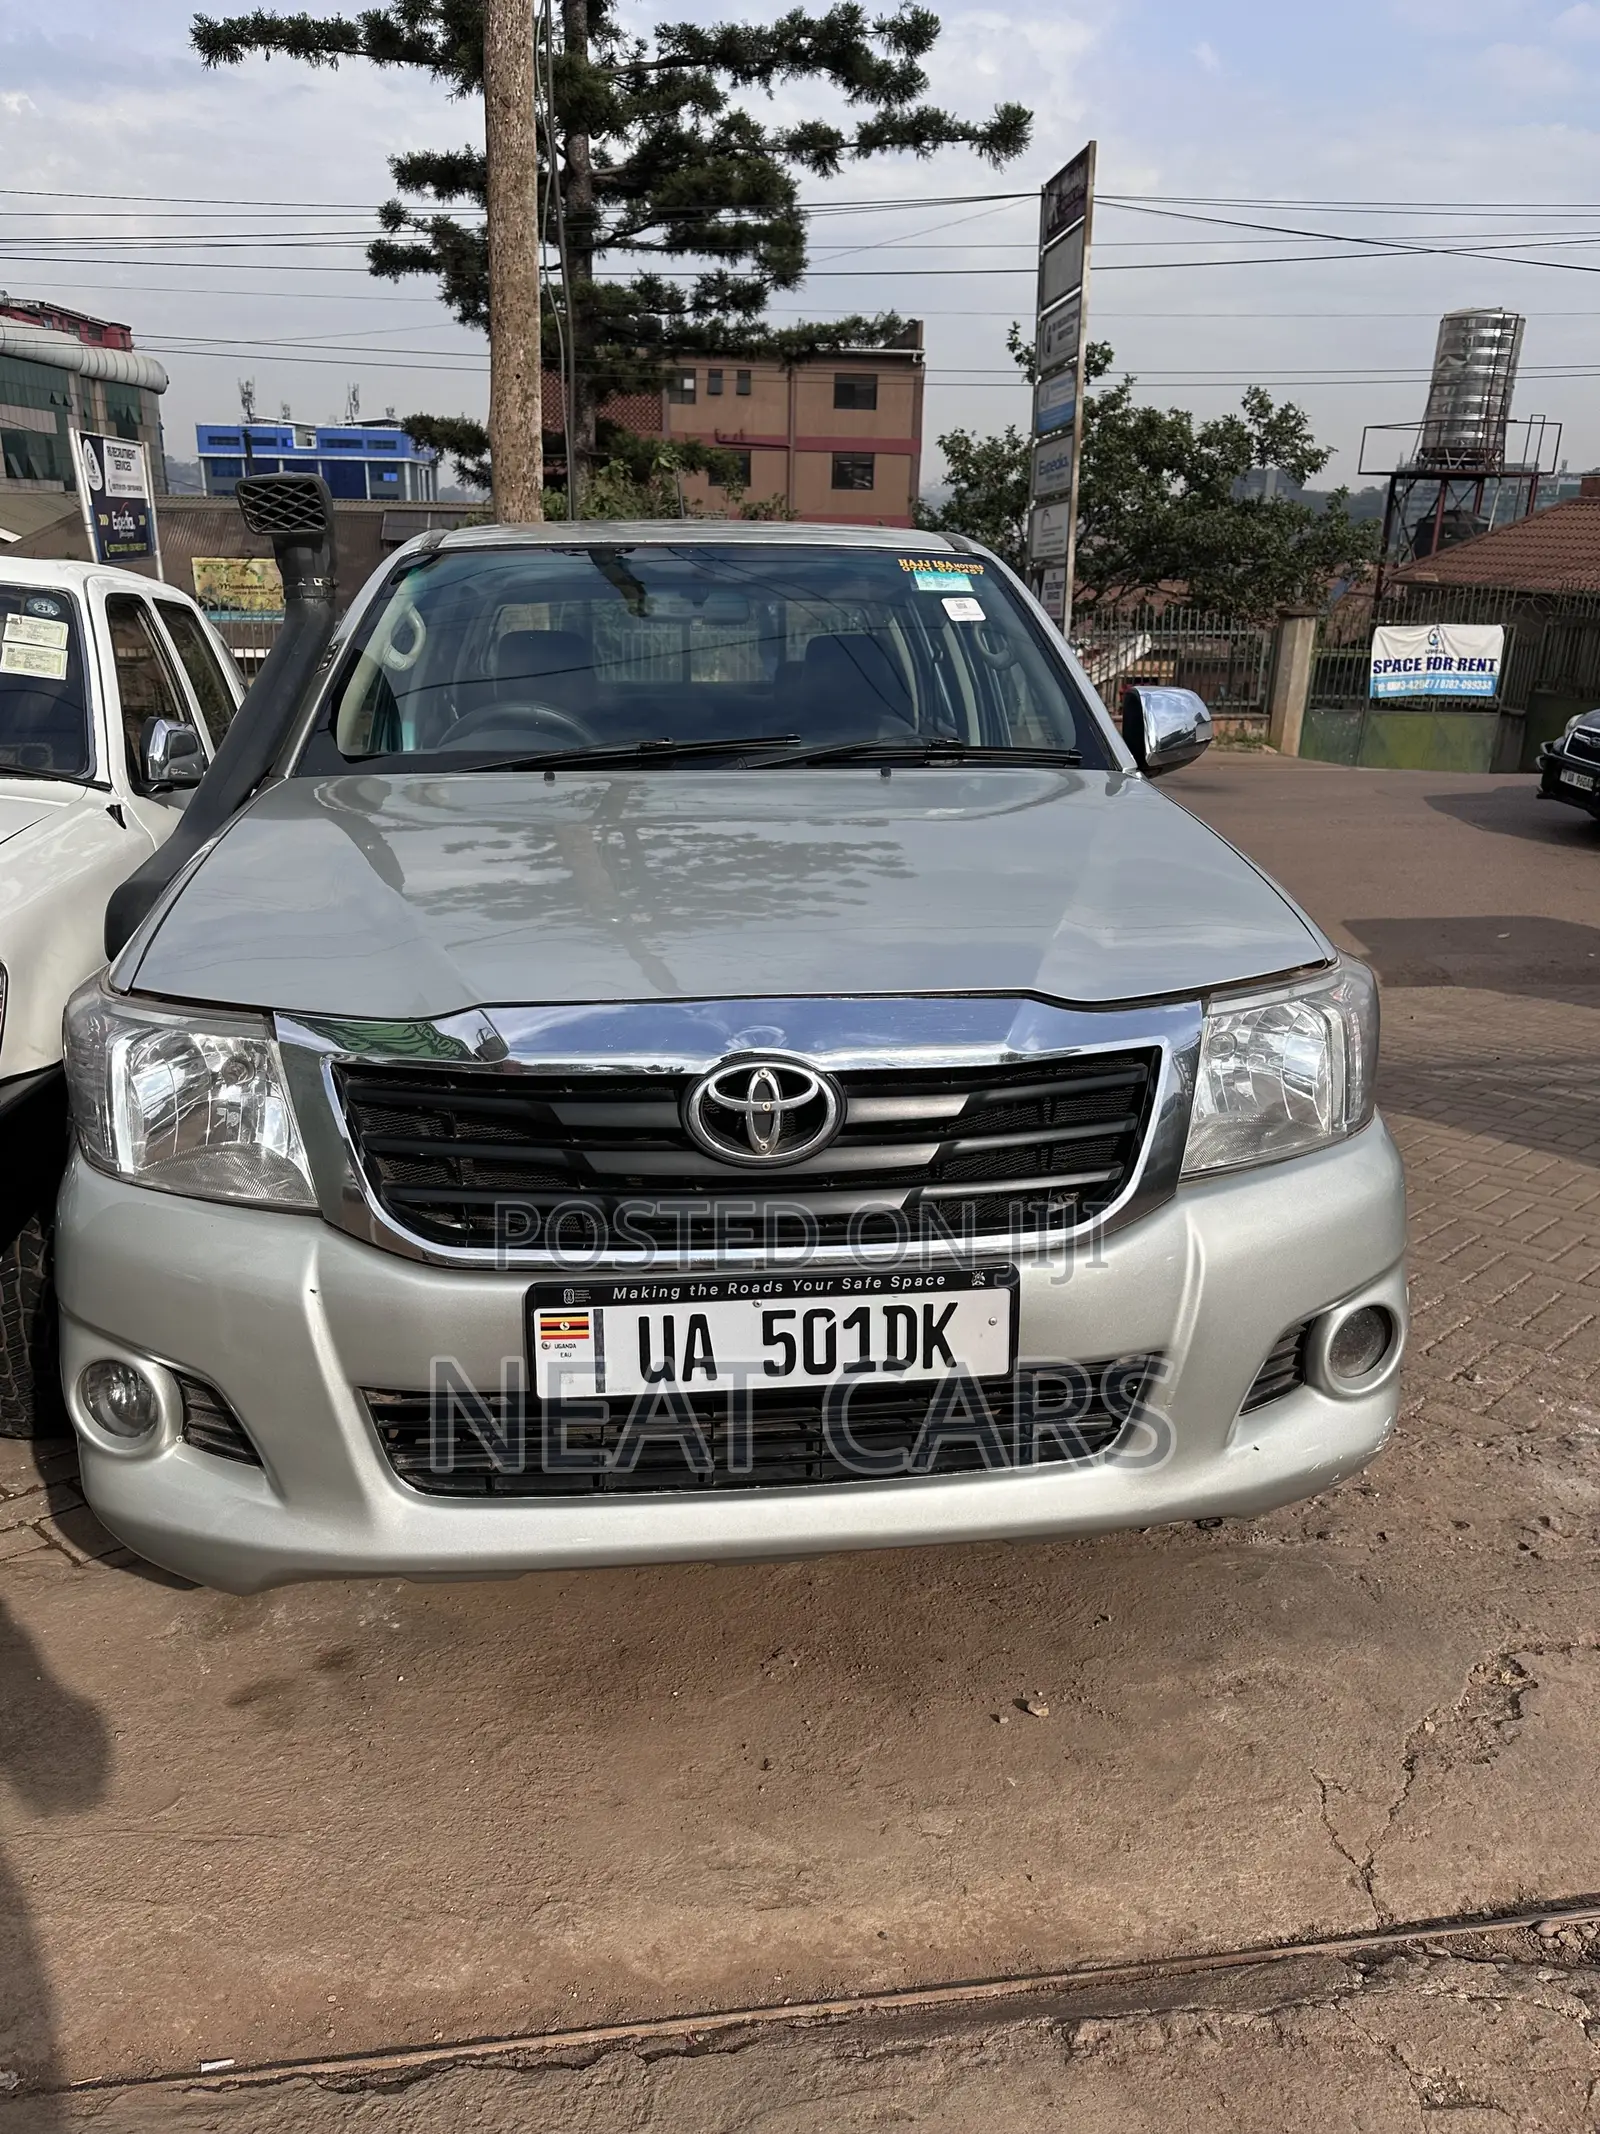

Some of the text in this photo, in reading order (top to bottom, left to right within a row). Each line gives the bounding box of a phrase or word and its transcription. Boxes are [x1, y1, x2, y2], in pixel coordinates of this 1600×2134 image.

[898, 559, 931, 567] HAJJ
[932, 560, 954, 569] ISA
[1373, 657, 1498, 674] SPACE FOR RENT
[612, 1275, 946, 1300] Making the Roads Your Safe Space
[638, 1301, 959, 1384] UA 501DK
